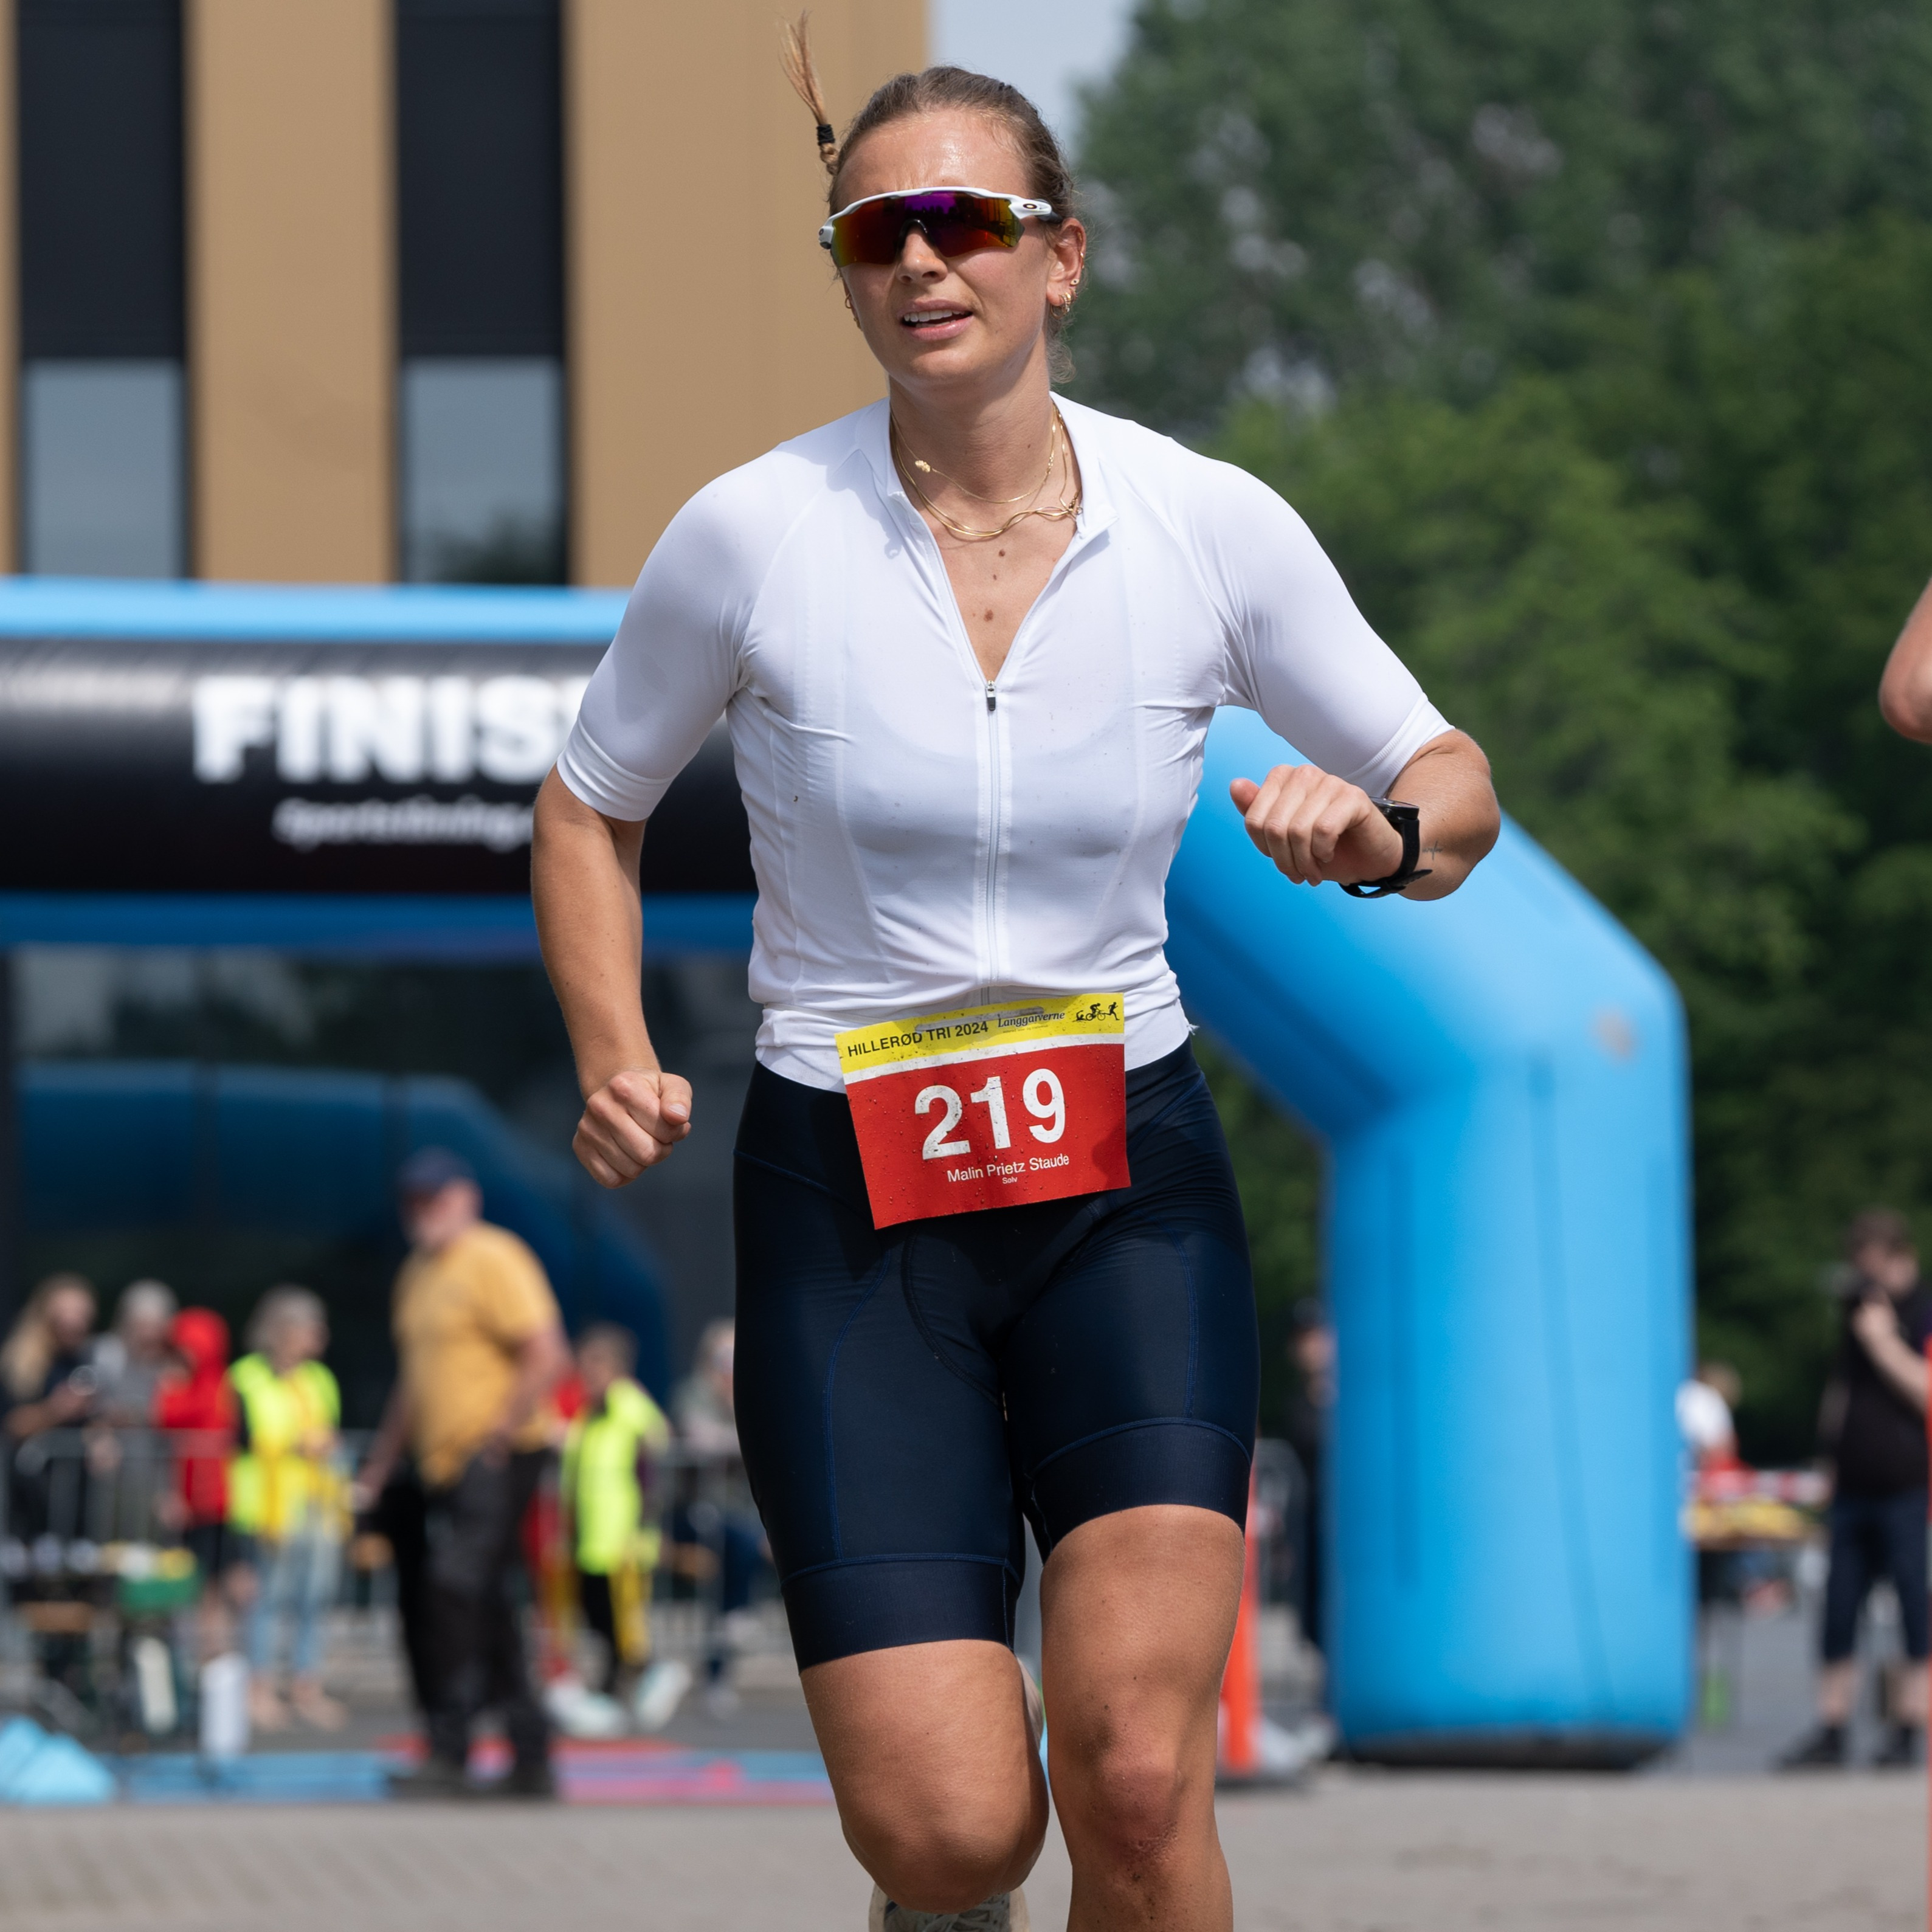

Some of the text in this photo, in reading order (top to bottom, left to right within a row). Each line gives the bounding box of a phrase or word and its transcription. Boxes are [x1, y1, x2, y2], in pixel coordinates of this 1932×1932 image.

[192, 674, 588, 784] FINIS
[847, 1032, 922, 1057] HILLERØD
[926, 1027, 950, 1041] TRI
[955, 1021, 988, 1037] 2024
[915, 1068, 1065, 1160] 219
[947, 1153, 1070, 1182] Malin Prietz Staude
